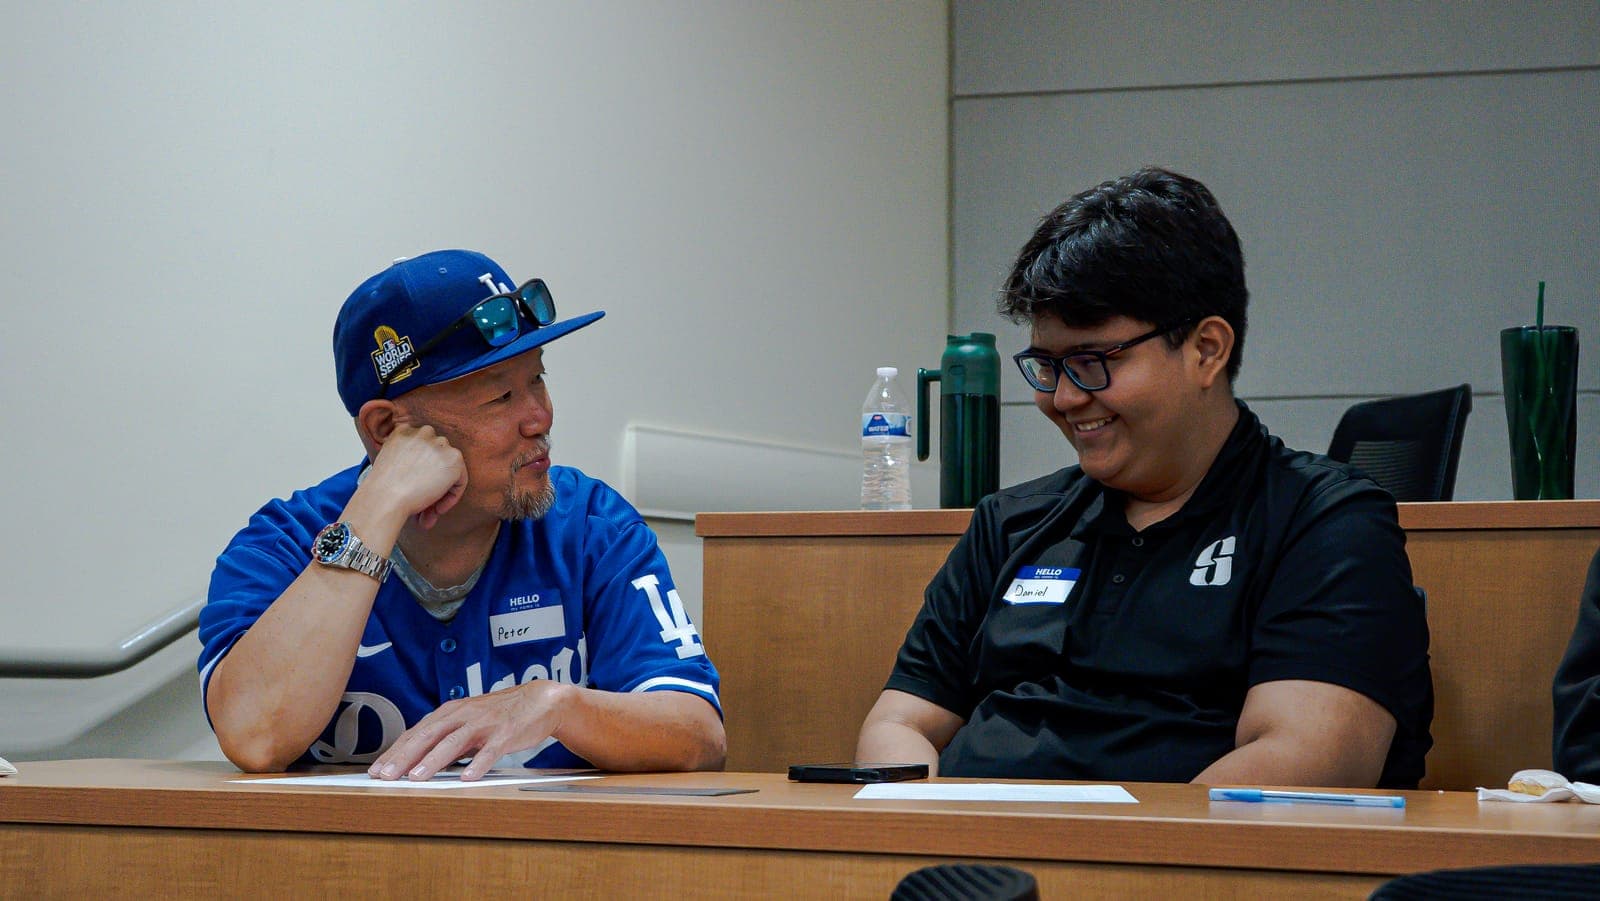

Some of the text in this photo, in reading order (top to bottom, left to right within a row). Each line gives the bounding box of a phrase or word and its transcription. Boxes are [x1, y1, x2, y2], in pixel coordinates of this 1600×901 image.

[375, 342, 411, 366] WORLD
[1189, 535, 1237, 586] S
[1035, 568, 1063, 576] HELLO
[1015, 584, 1049, 597] Daniel
[509, 593, 540, 607] HELLO
[631, 574, 704, 660] LA
[498, 626, 530, 640] Peter
